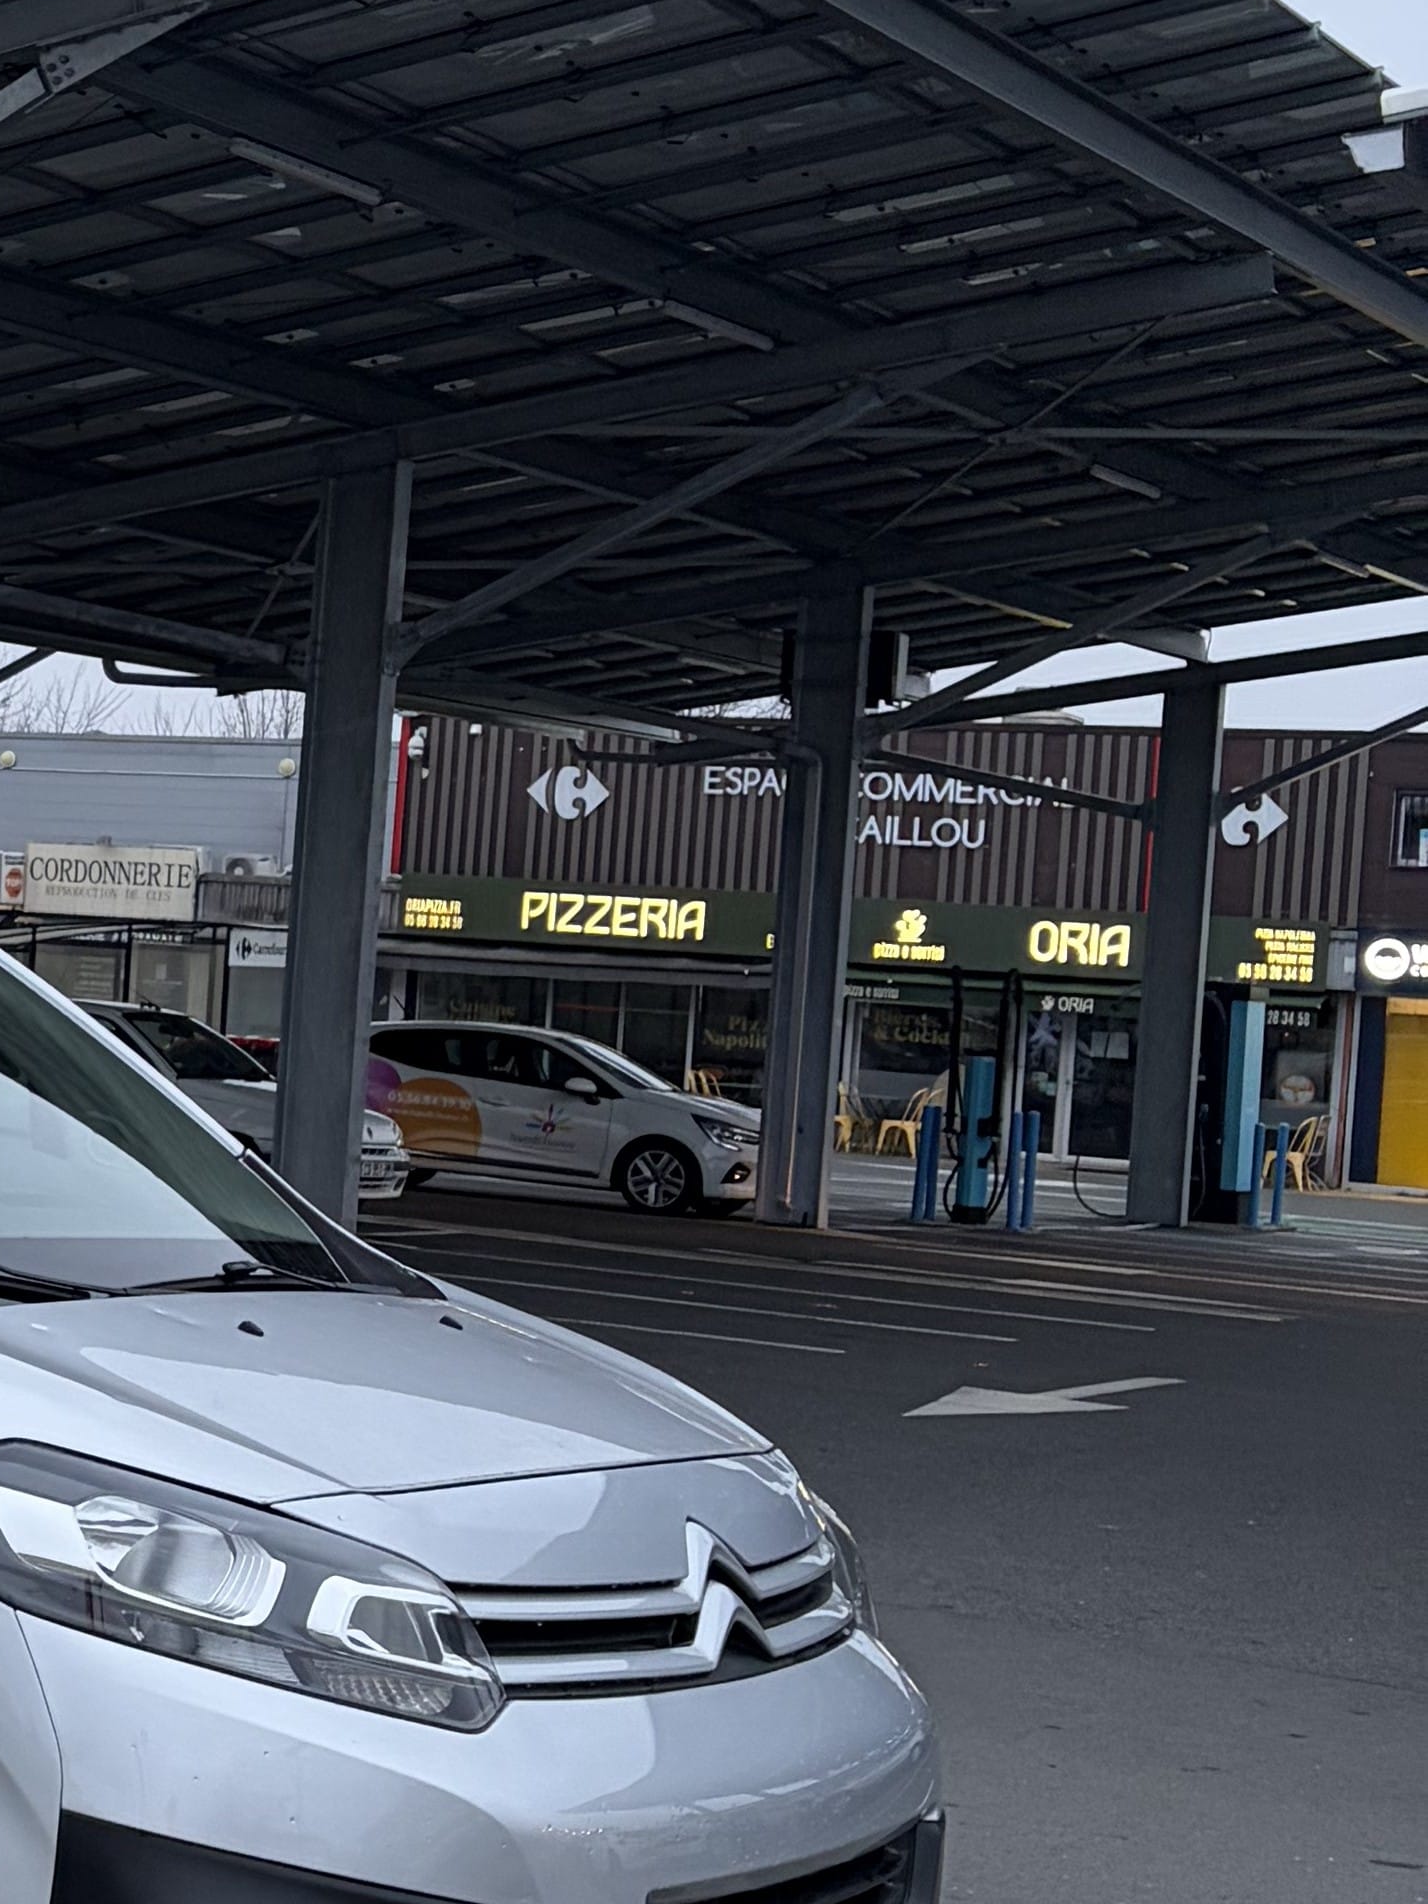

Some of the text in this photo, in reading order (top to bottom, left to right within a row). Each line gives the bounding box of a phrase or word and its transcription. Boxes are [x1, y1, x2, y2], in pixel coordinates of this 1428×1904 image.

[703, 765, 787, 796] ESPA
[854, 815, 986, 849] AILLOU
[29, 857, 192, 889] CORDONNERIE
[520, 891, 706, 941] PIZZERIA
[1029, 920, 1131, 967] ORIA
[1058, 996, 1094, 1014] ORIA
[1267, 1009, 1280, 1025] 28
[1281, 1010, 1295, 1026] 34
